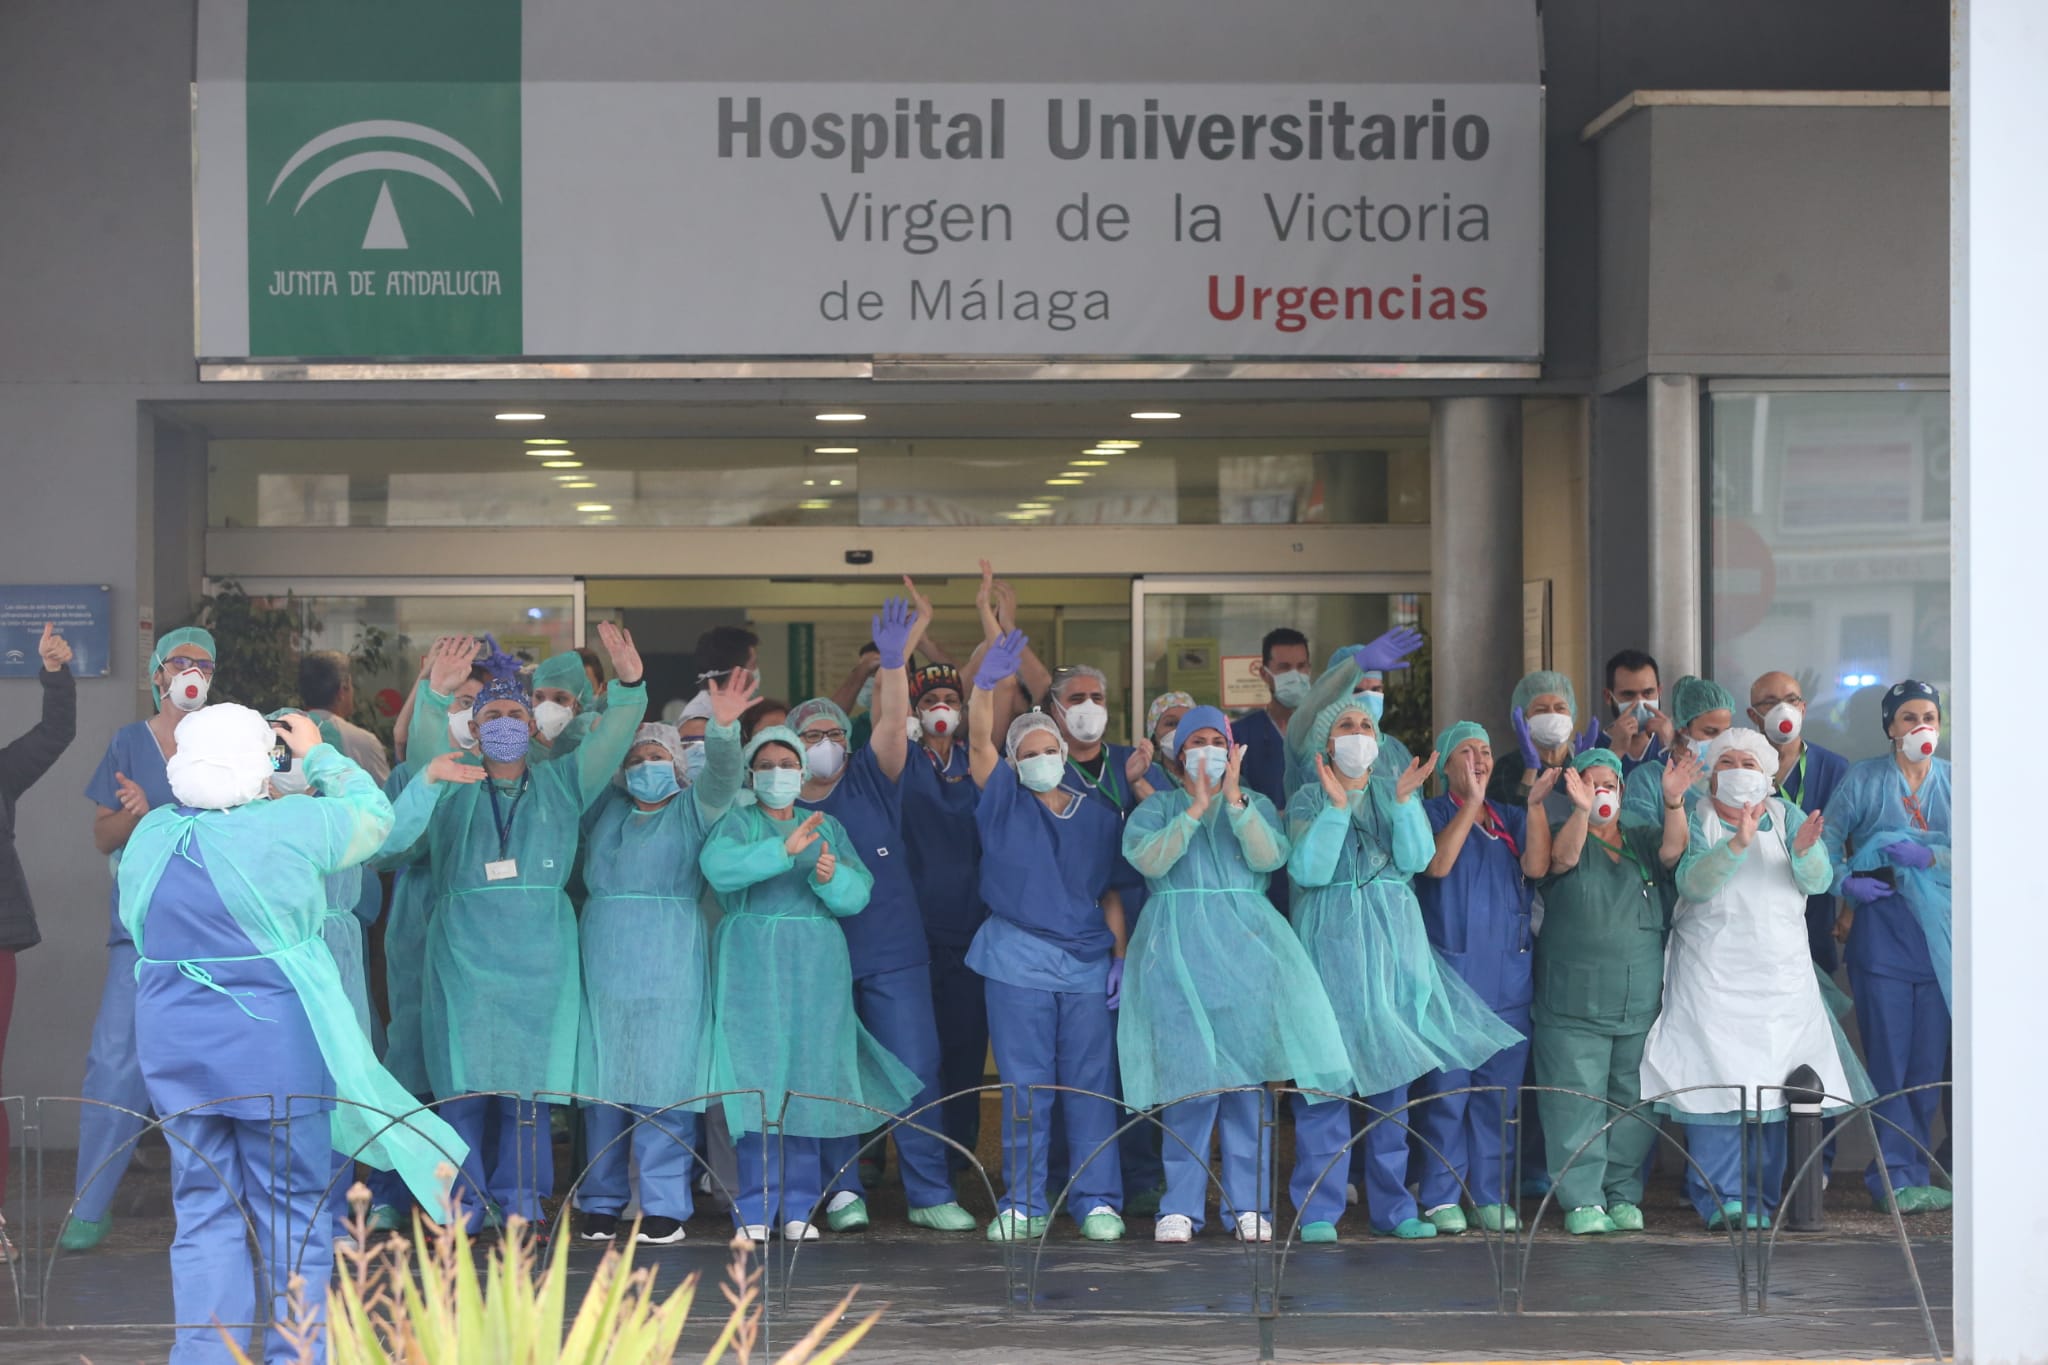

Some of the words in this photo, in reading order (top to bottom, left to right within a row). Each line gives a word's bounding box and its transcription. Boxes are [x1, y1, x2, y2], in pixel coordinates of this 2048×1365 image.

[716, 97, 1006, 173] Hospital
[1048, 99, 1491, 162] Universitario
[821, 193, 1013, 256] Virgen
[1056, 193, 1131, 243] de
[1174, 193, 1222, 243] la
[1264, 193, 1492, 244] Victoria
[268, 271, 338, 296] JUNTA
[348, 271, 377, 296] DE
[820, 280, 884, 322] de
[909, 279, 1110, 332] Málaga
[1208, 275, 1489, 333] Urgencias
